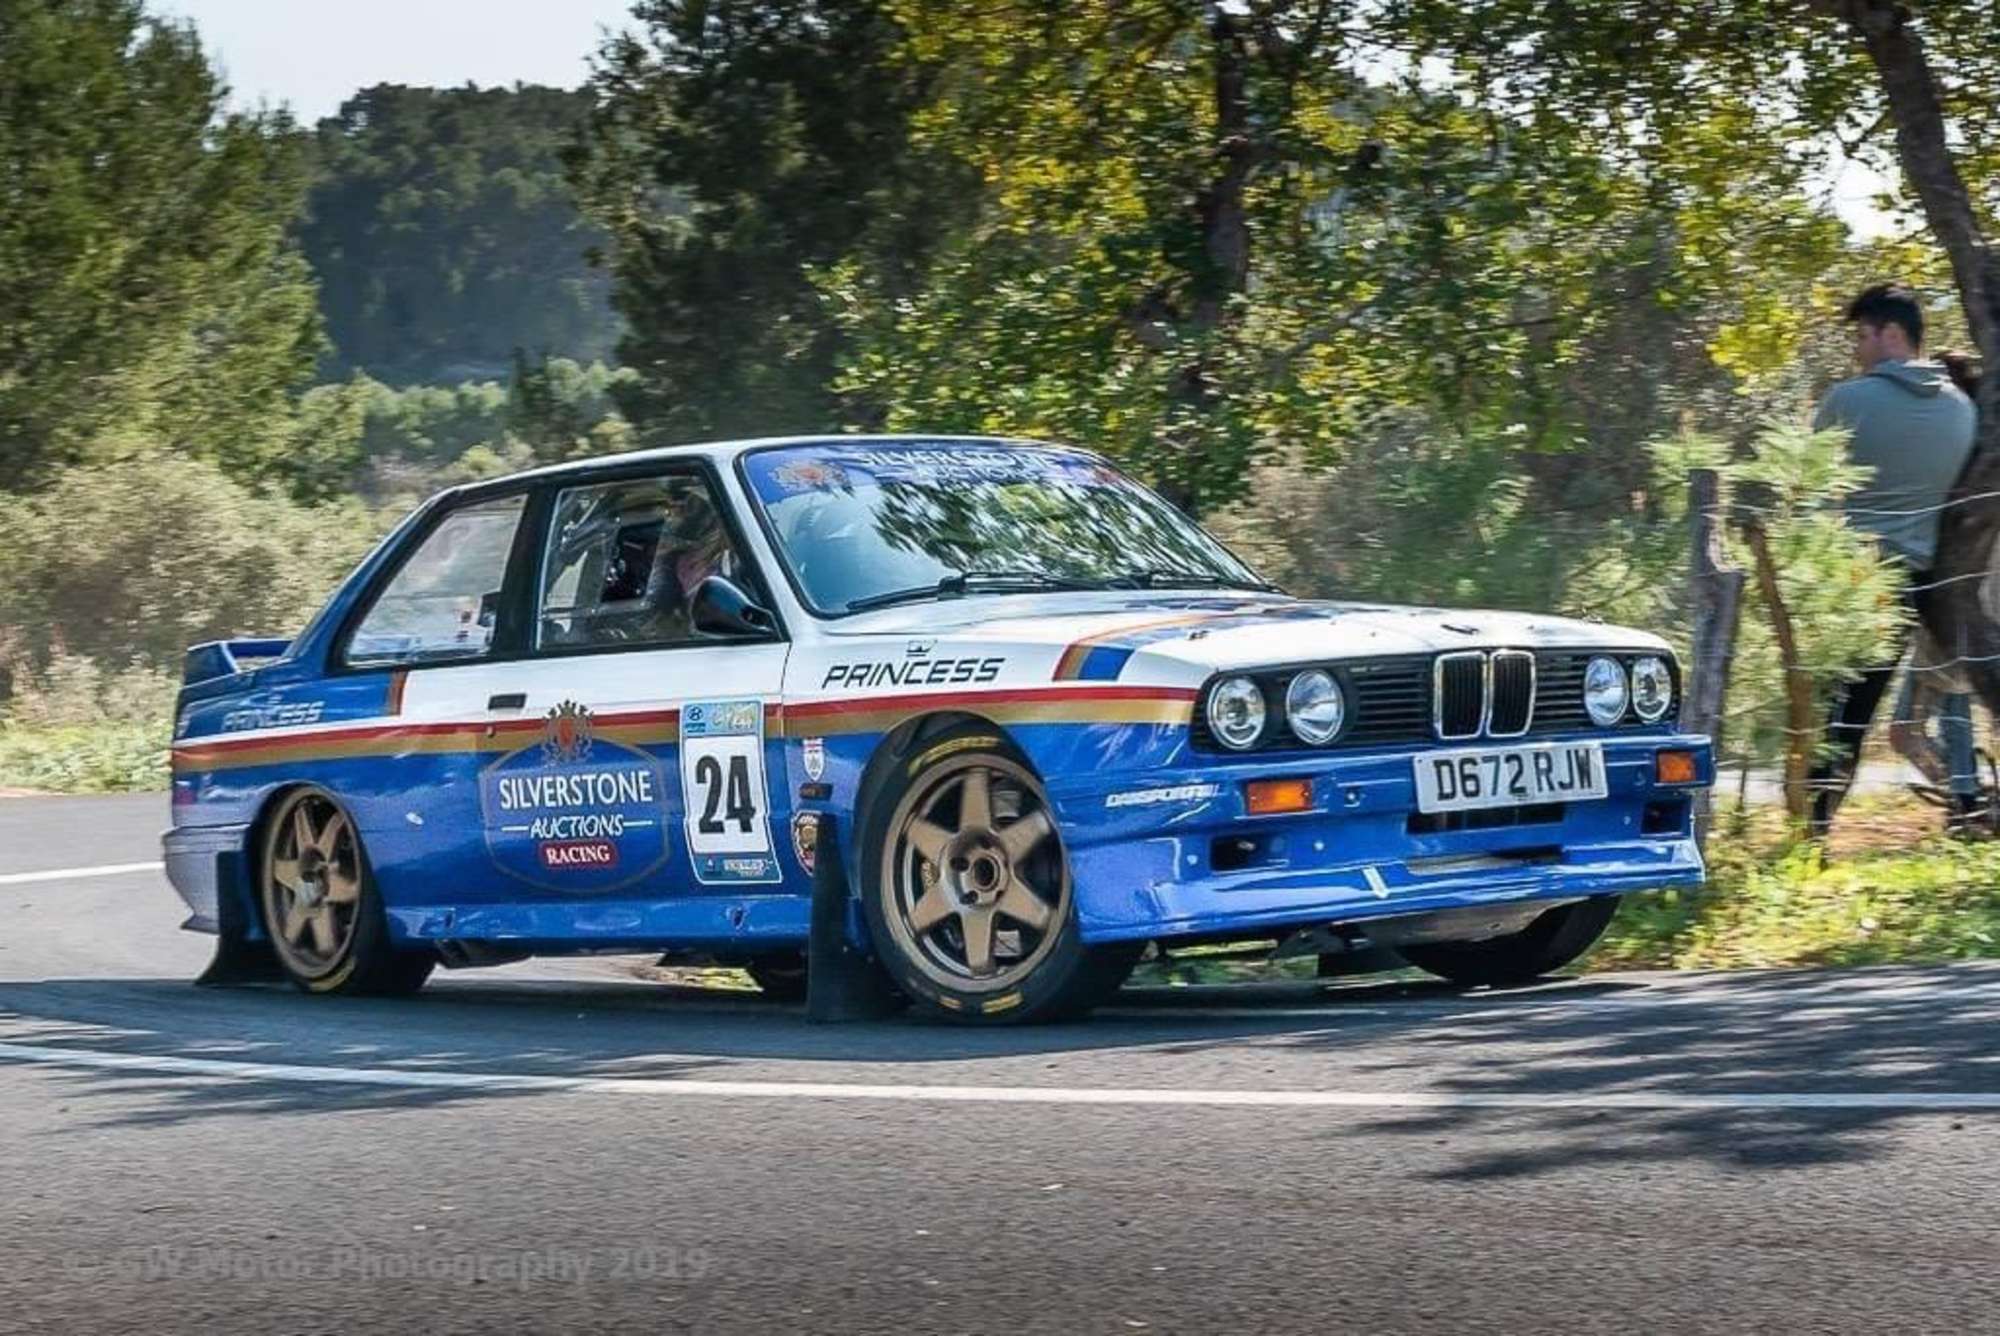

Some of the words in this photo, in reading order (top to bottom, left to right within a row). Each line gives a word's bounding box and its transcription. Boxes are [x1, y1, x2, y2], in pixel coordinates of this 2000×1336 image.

[821, 657, 1005, 689] PRINCESS
[223, 701, 326, 731] PRINCESS
[499, 770, 653, 810] SILVERSTONE
[1433, 752, 1527, 802] D672
[1533, 747, 1593, 793] RJW
[695, 755, 756, 834] 24
[529, 814, 625, 839] AUCTIONS
[545, 844, 611, 864] RACING
